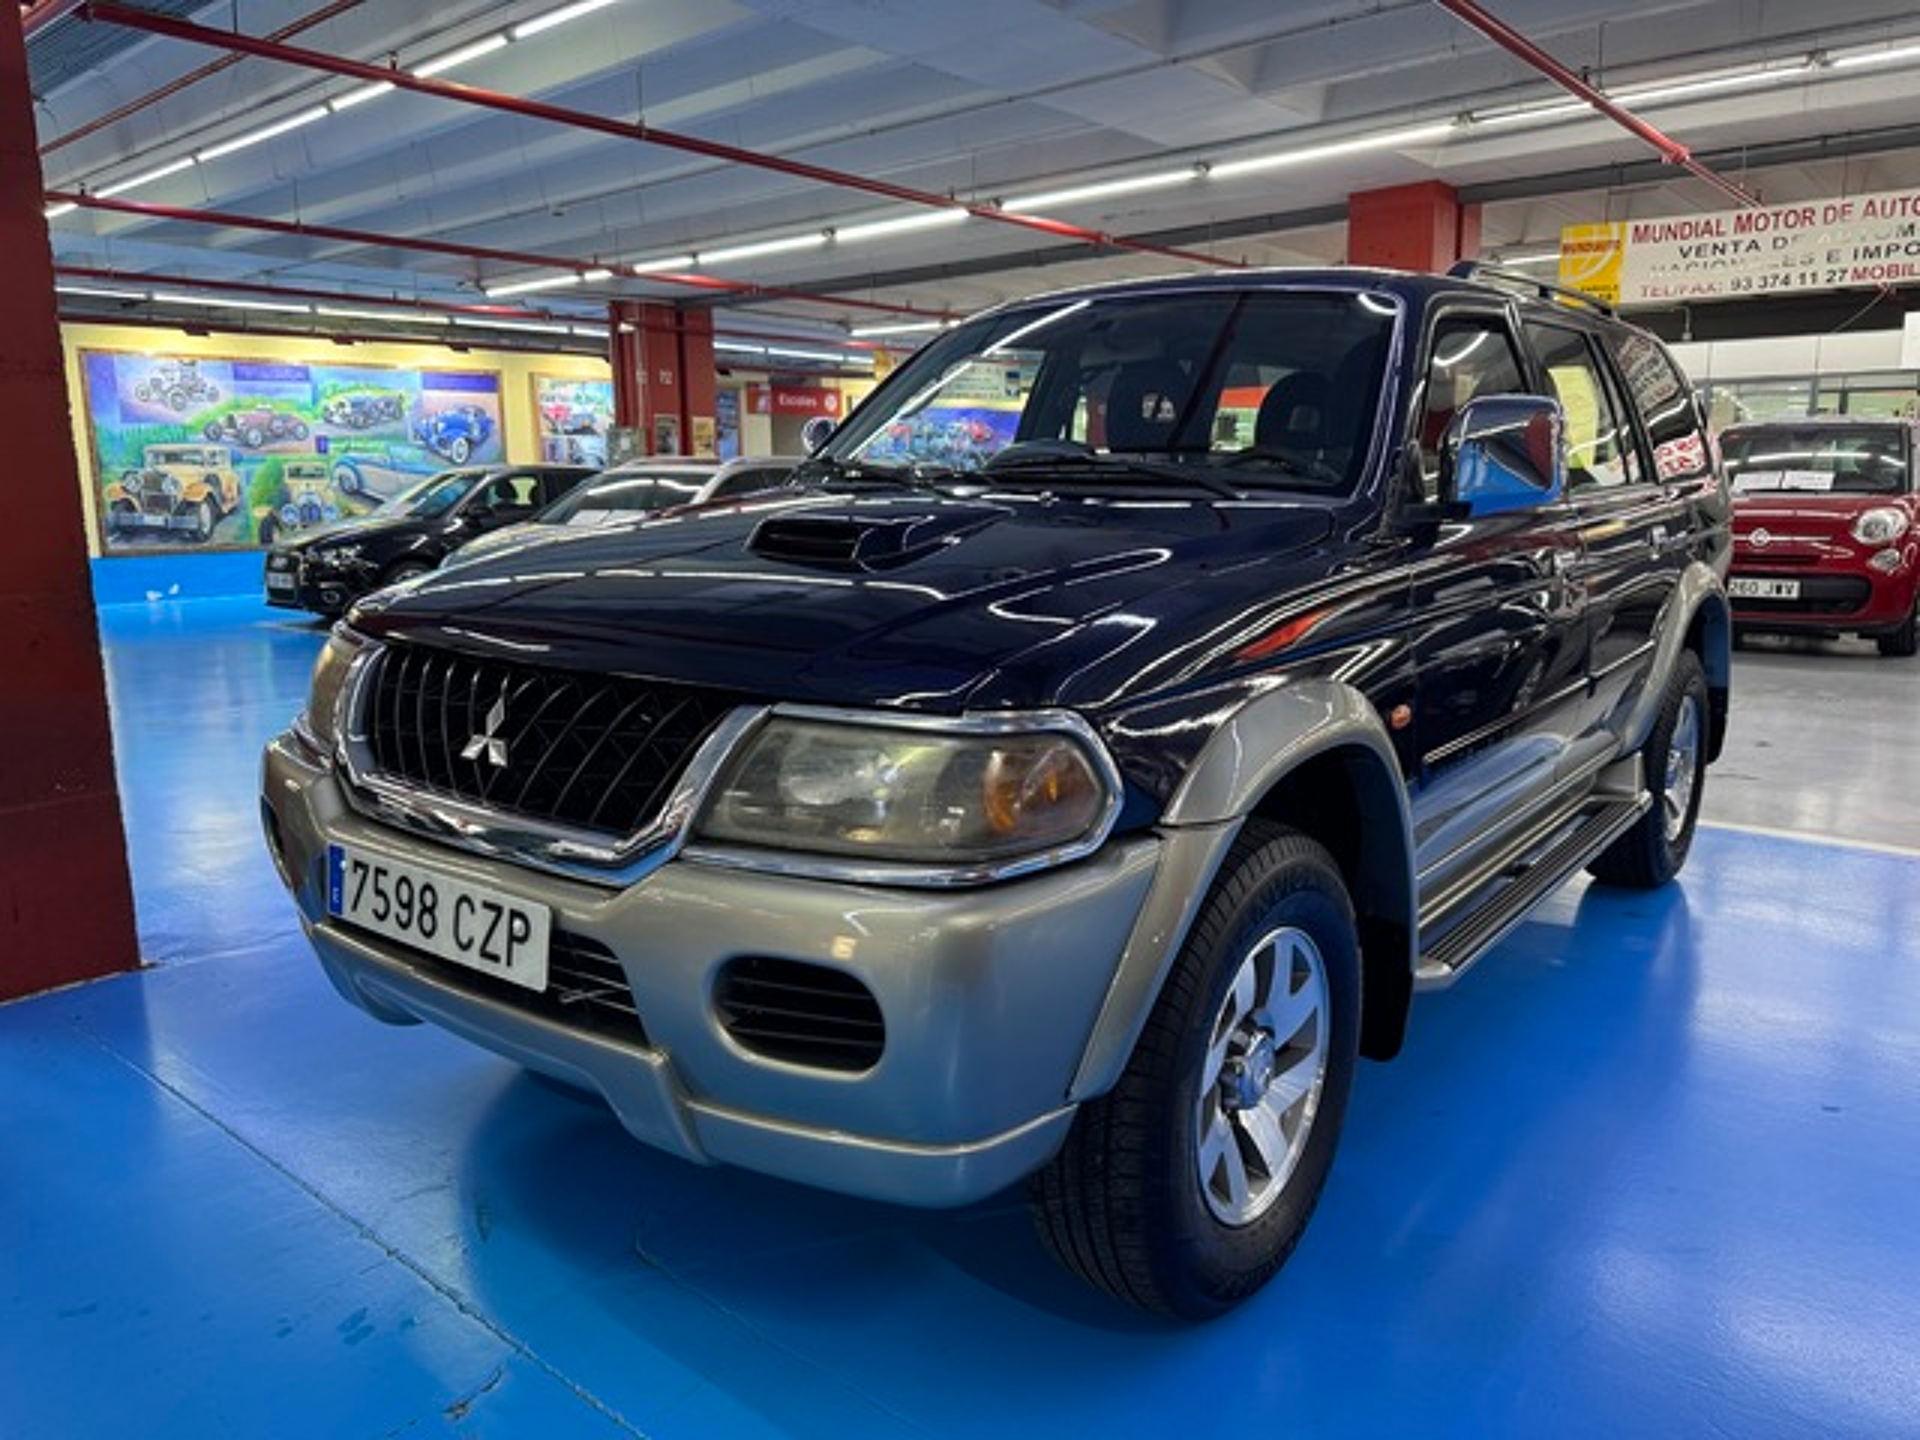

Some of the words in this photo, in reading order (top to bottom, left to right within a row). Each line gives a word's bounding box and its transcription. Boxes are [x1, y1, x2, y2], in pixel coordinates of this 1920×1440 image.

[1632, 218, 1727, 244] MUNDIAL
[1734, 207, 1816, 234] MOTOR
[1824, 203, 1854, 226] DE
[1679, 239, 1761, 258] VENTA
[1826, 249, 1841, 264] E
[1730, 276, 1753, 291] 93
[1757, 272, 1791, 289] 374
[1798, 271, 1818, 285] 11
[1826, 268, 1848, 283] 27
[351, 859, 439, 940] 7598
[453, 893, 532, 968] CZP
